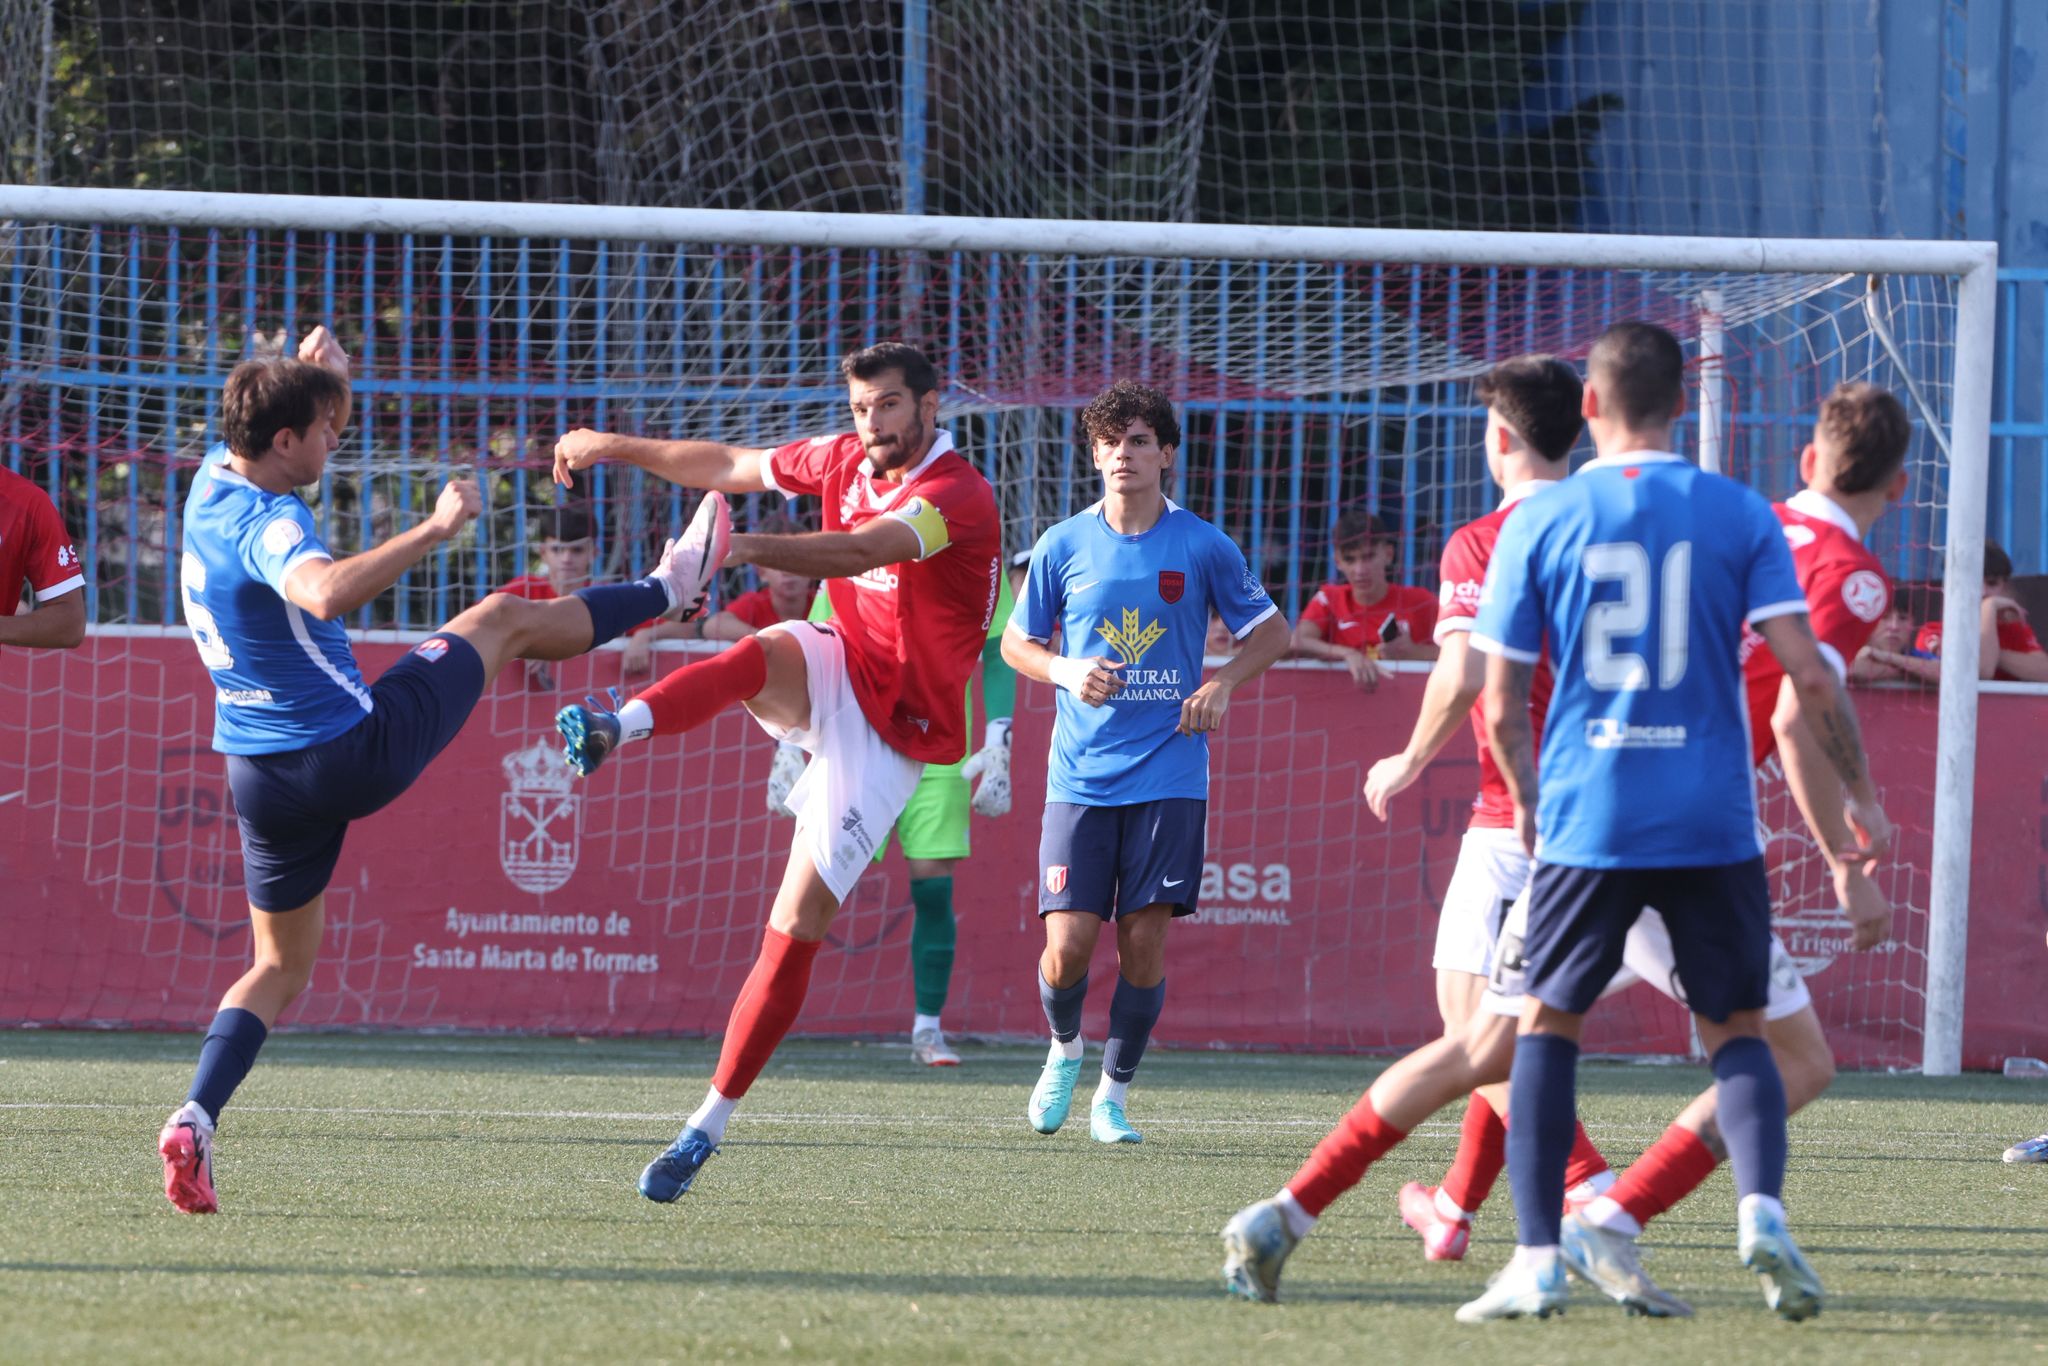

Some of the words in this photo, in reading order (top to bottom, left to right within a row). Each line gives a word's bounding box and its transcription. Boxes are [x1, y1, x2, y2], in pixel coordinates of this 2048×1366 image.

[1582, 540, 1692, 691] 21
[1126, 669, 1181, 685] RURAL
[446, 907, 600, 938] Ayuntamiento
[604, 910, 631, 936] de
[413, 943, 475, 969] Santa
[481, 944, 546, 970] Marta
[551, 946, 578, 971] de
[581, 946, 659, 973] Tormes
